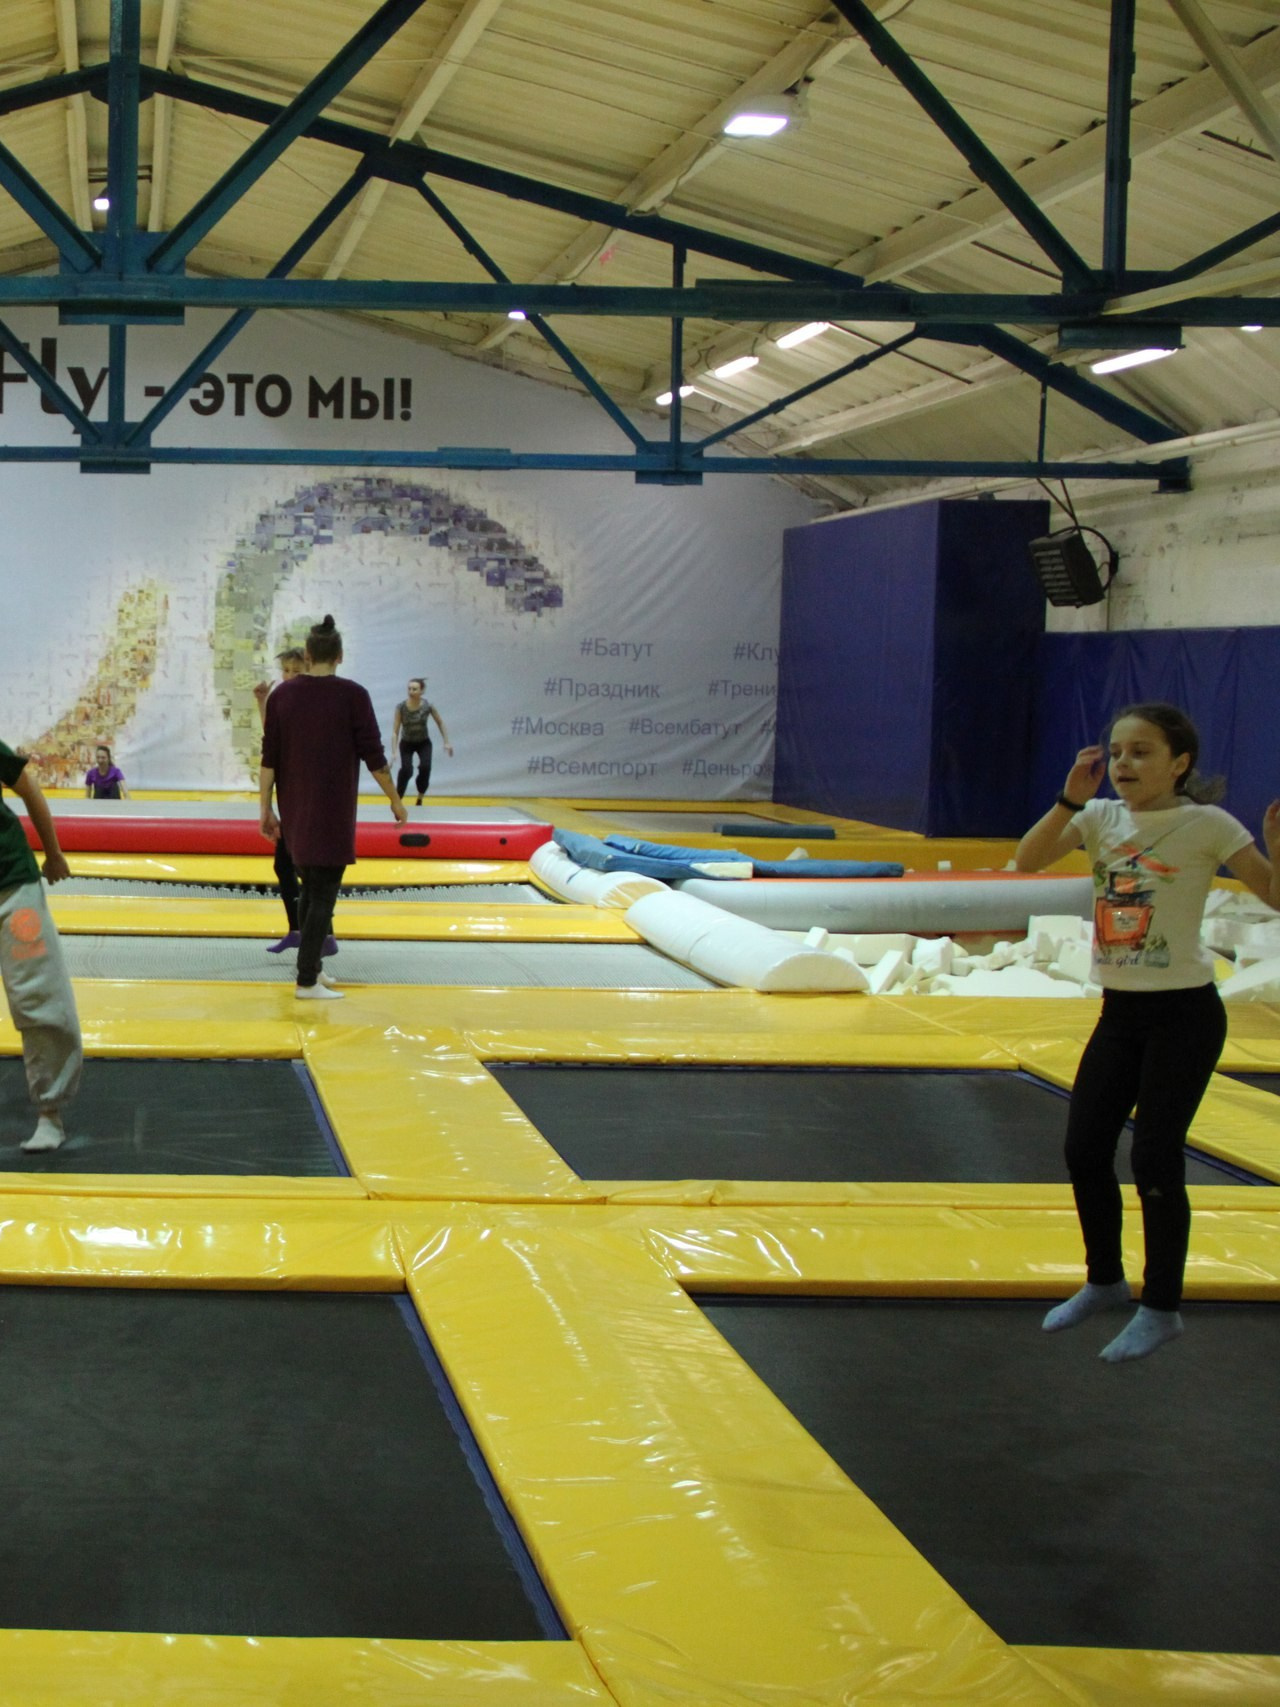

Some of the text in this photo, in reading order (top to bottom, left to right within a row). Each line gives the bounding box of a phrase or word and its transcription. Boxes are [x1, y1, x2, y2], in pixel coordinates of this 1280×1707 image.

[580, 637, 653, 661] #Батут
[544, 678, 661, 701] #Праздник
[511, 716, 605, 736] #Москва
[628, 718, 742, 740] #Всембатут
[527, 755, 658, 779] #Всемспорт
